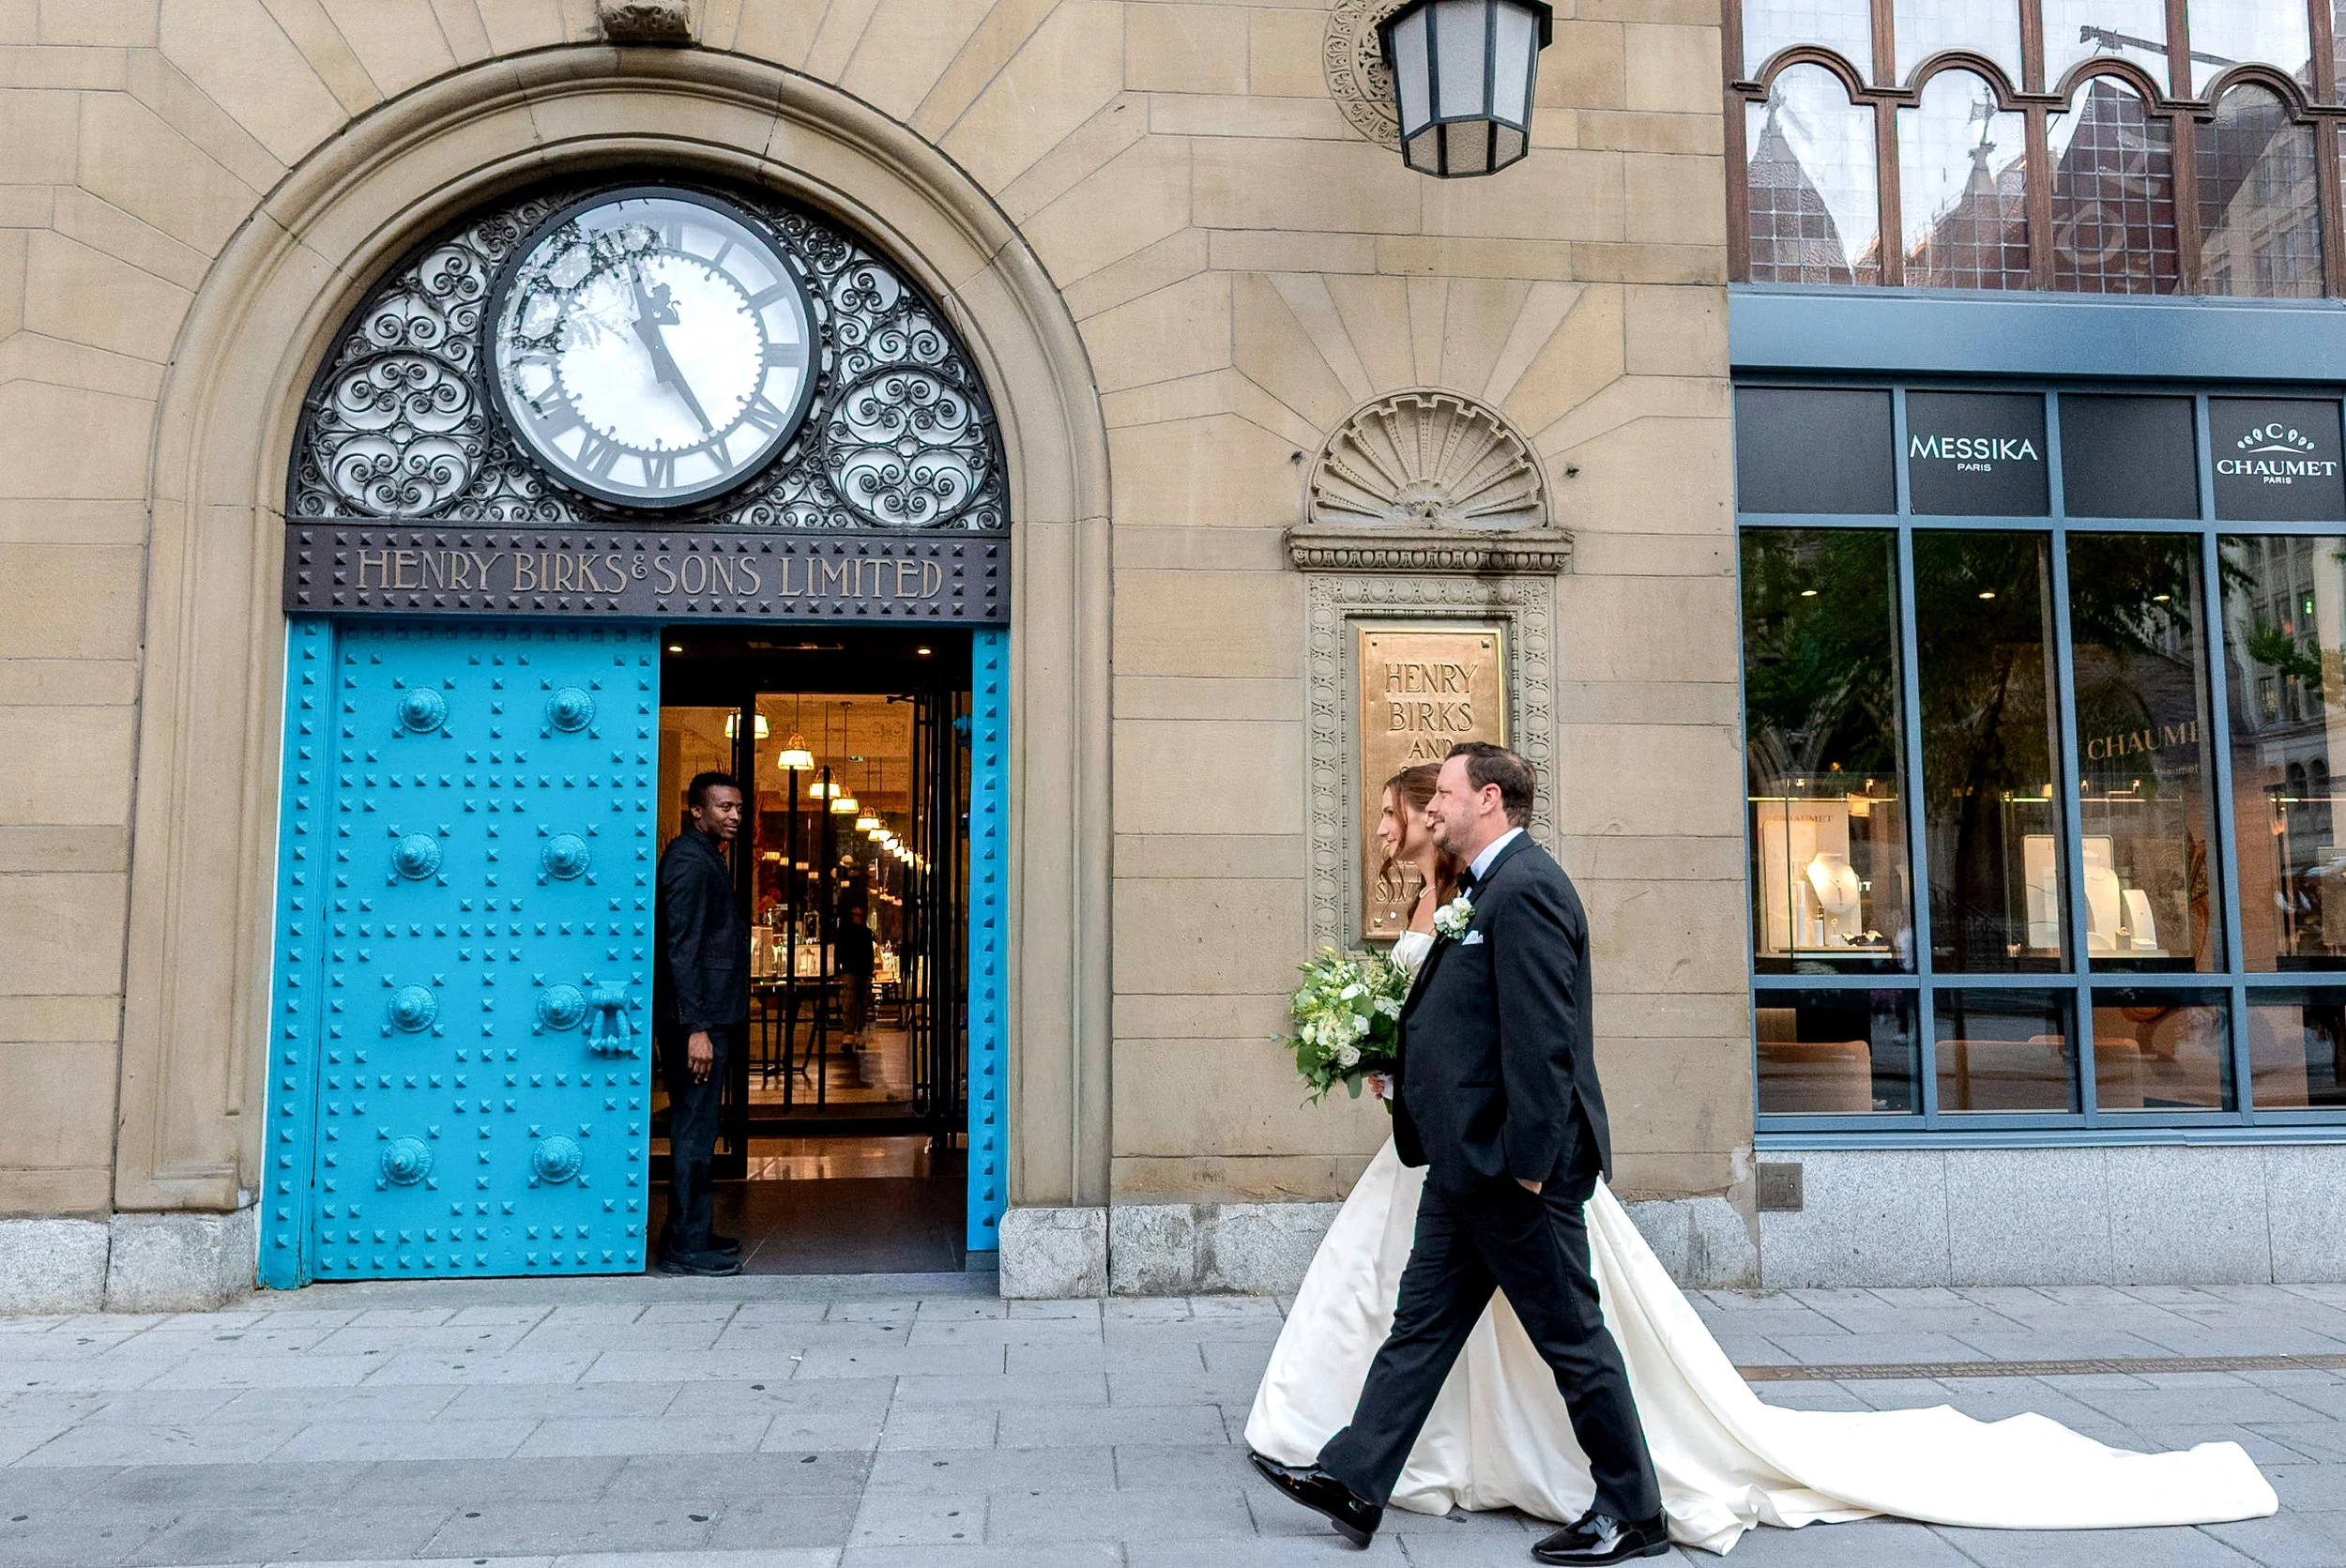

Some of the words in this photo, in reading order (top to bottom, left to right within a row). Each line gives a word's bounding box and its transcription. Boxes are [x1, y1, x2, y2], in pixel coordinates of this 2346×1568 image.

[2265, 422, 2283, 439] C
[1910, 434, 2038, 461] MESSIKA
[1957, 463, 1991, 472] PARIS
[2217, 459, 2338, 477] CHAUMET
[2263, 476, 2292, 484] PARIS
[356, 549, 505, 591] HENRY
[512, 552, 628, 594] BIRKS
[631, 555, 647, 580] &
[654, 556, 761, 596] SONS
[778, 557, 943, 599] LIMITED
[1384, 662, 1478, 693] HENRY
[1388, 700, 1474, 732] BIRKS
